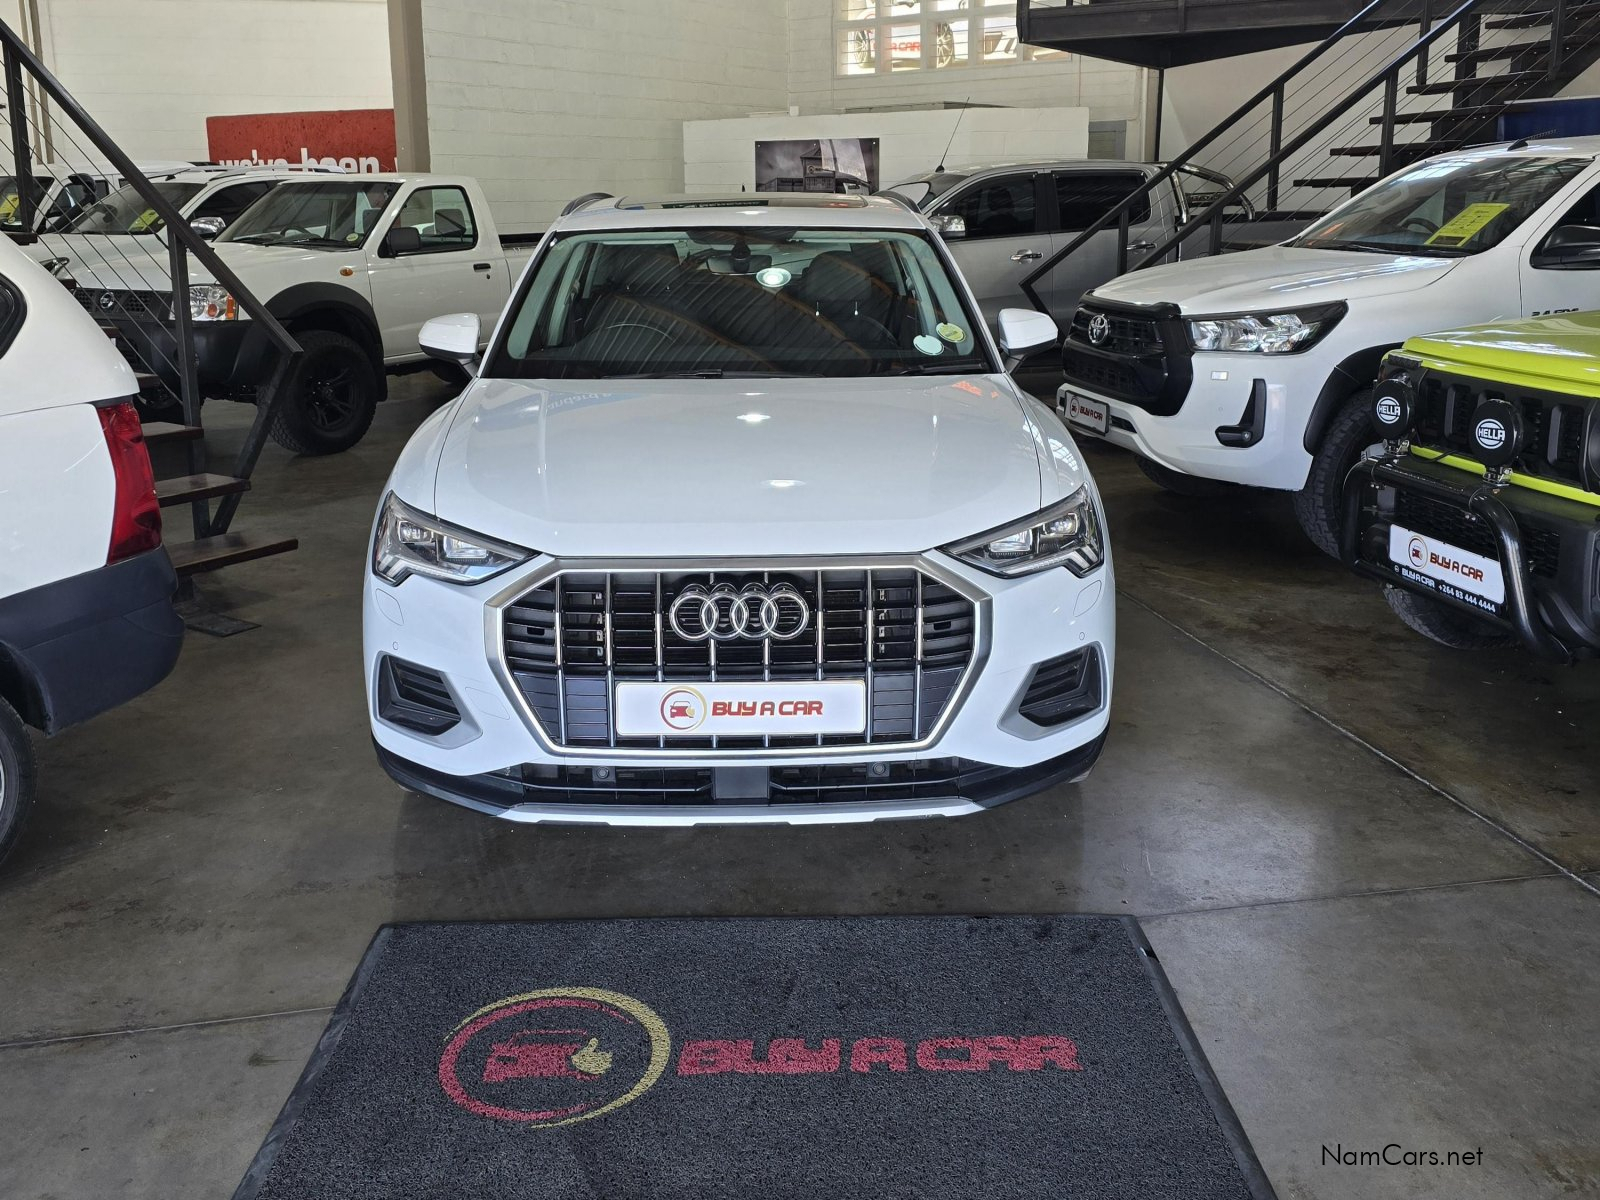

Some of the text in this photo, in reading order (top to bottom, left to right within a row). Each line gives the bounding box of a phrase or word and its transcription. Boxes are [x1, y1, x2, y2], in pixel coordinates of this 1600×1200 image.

[1378, 405, 1400, 416] HELLA
[1478, 428, 1505, 441] HELLA
[1430, 552, 1484, 582] BUY A CAR
[1401, 568, 1496, 613] BUY A CAR +264 83 444 4444
[711, 700, 823, 716] BUY A CAR
[677, 1034, 1084, 1076] BUY A CAR
